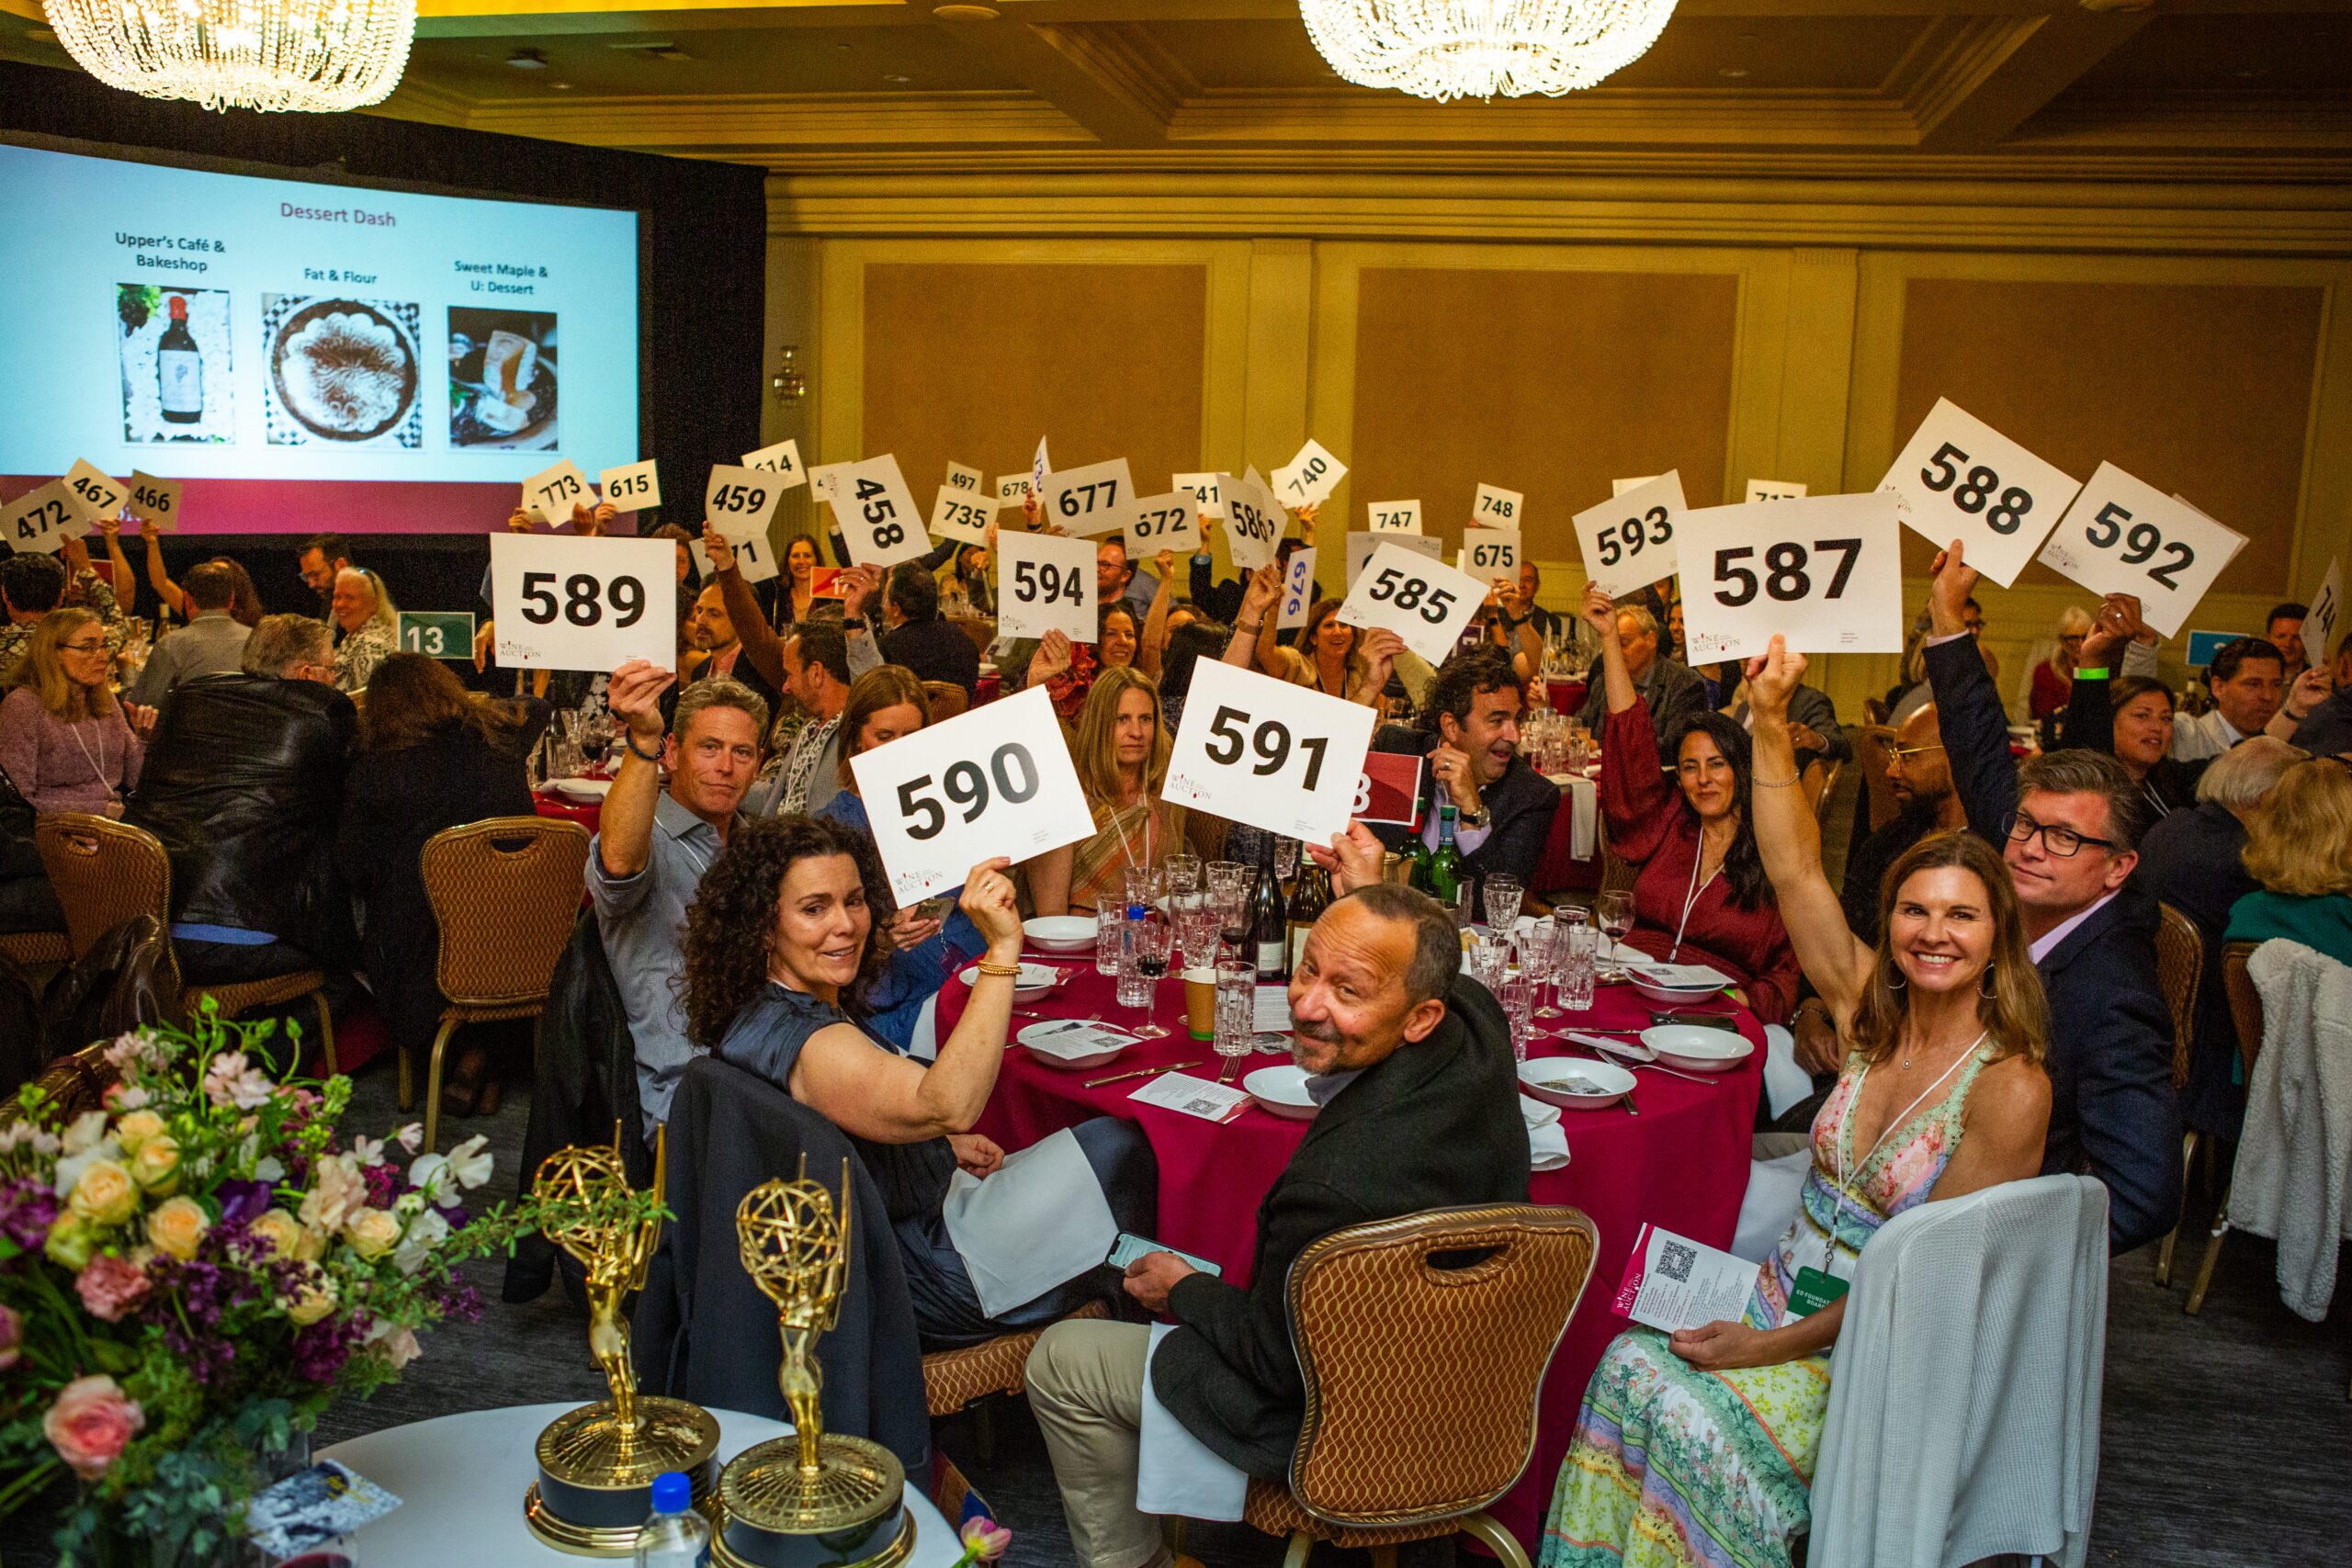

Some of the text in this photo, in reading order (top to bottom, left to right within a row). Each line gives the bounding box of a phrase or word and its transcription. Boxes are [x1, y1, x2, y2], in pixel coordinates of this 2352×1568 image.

[281, 203, 396, 227] Dessert Dash
[177, 236, 210, 252] Café
[213, 241, 226, 254] &
[136, 254, 208, 273] Bakeshop
[304, 267, 377, 284] Fat & Flour
[454, 260, 549, 279] Sweet Maple &
[487, 281, 535, 295] Dessert
[538, 475, 581, 507] 773
[610, 474, 649, 497] 615
[951, 472, 976, 491] 497
[1001, 481, 1029, 496] 678
[1288, 457, 1328, 497] 740
[1921, 441, 2033, 535] 588
[73, 477, 118, 508] 467
[134, 485, 171, 513] 466
[712, 484, 766, 514] 459
[1059, 479, 1117, 516] 677
[1182, 486, 1218, 503] 41
[1481, 496, 1513, 518] 748
[17, 500, 73, 539] 472
[854, 478, 905, 549] 458
[944, 501, 988, 529] 735
[1135, 507, 1187, 537] 672
[1231, 501, 1268, 543] 586
[1377, 512, 1412, 529] 747
[1597, 505, 1673, 566] 593
[2086, 501, 2195, 592] 592
[1474, 544, 1513, 568] 675
[1015, 560, 1083, 607] 594
[1713, 538, 1862, 607] 587
[521, 571, 645, 628] 589
[1287, 560, 1306, 616] 676
[1369, 568, 1457, 624] 585
[407, 626, 444, 655] 13
[500, 649, 541, 660] AUCTION
[1691, 638, 1740, 652] AUCTION
[1204, 705, 1329, 792] 591
[897, 742, 1039, 840] 590
[1170, 782, 1212, 799] AUCTION
[898, 870, 943, 894] AUCTION
[1615, 1284, 1631, 1309] WINE
[1623, 1273, 1642, 1312] AUCTION
